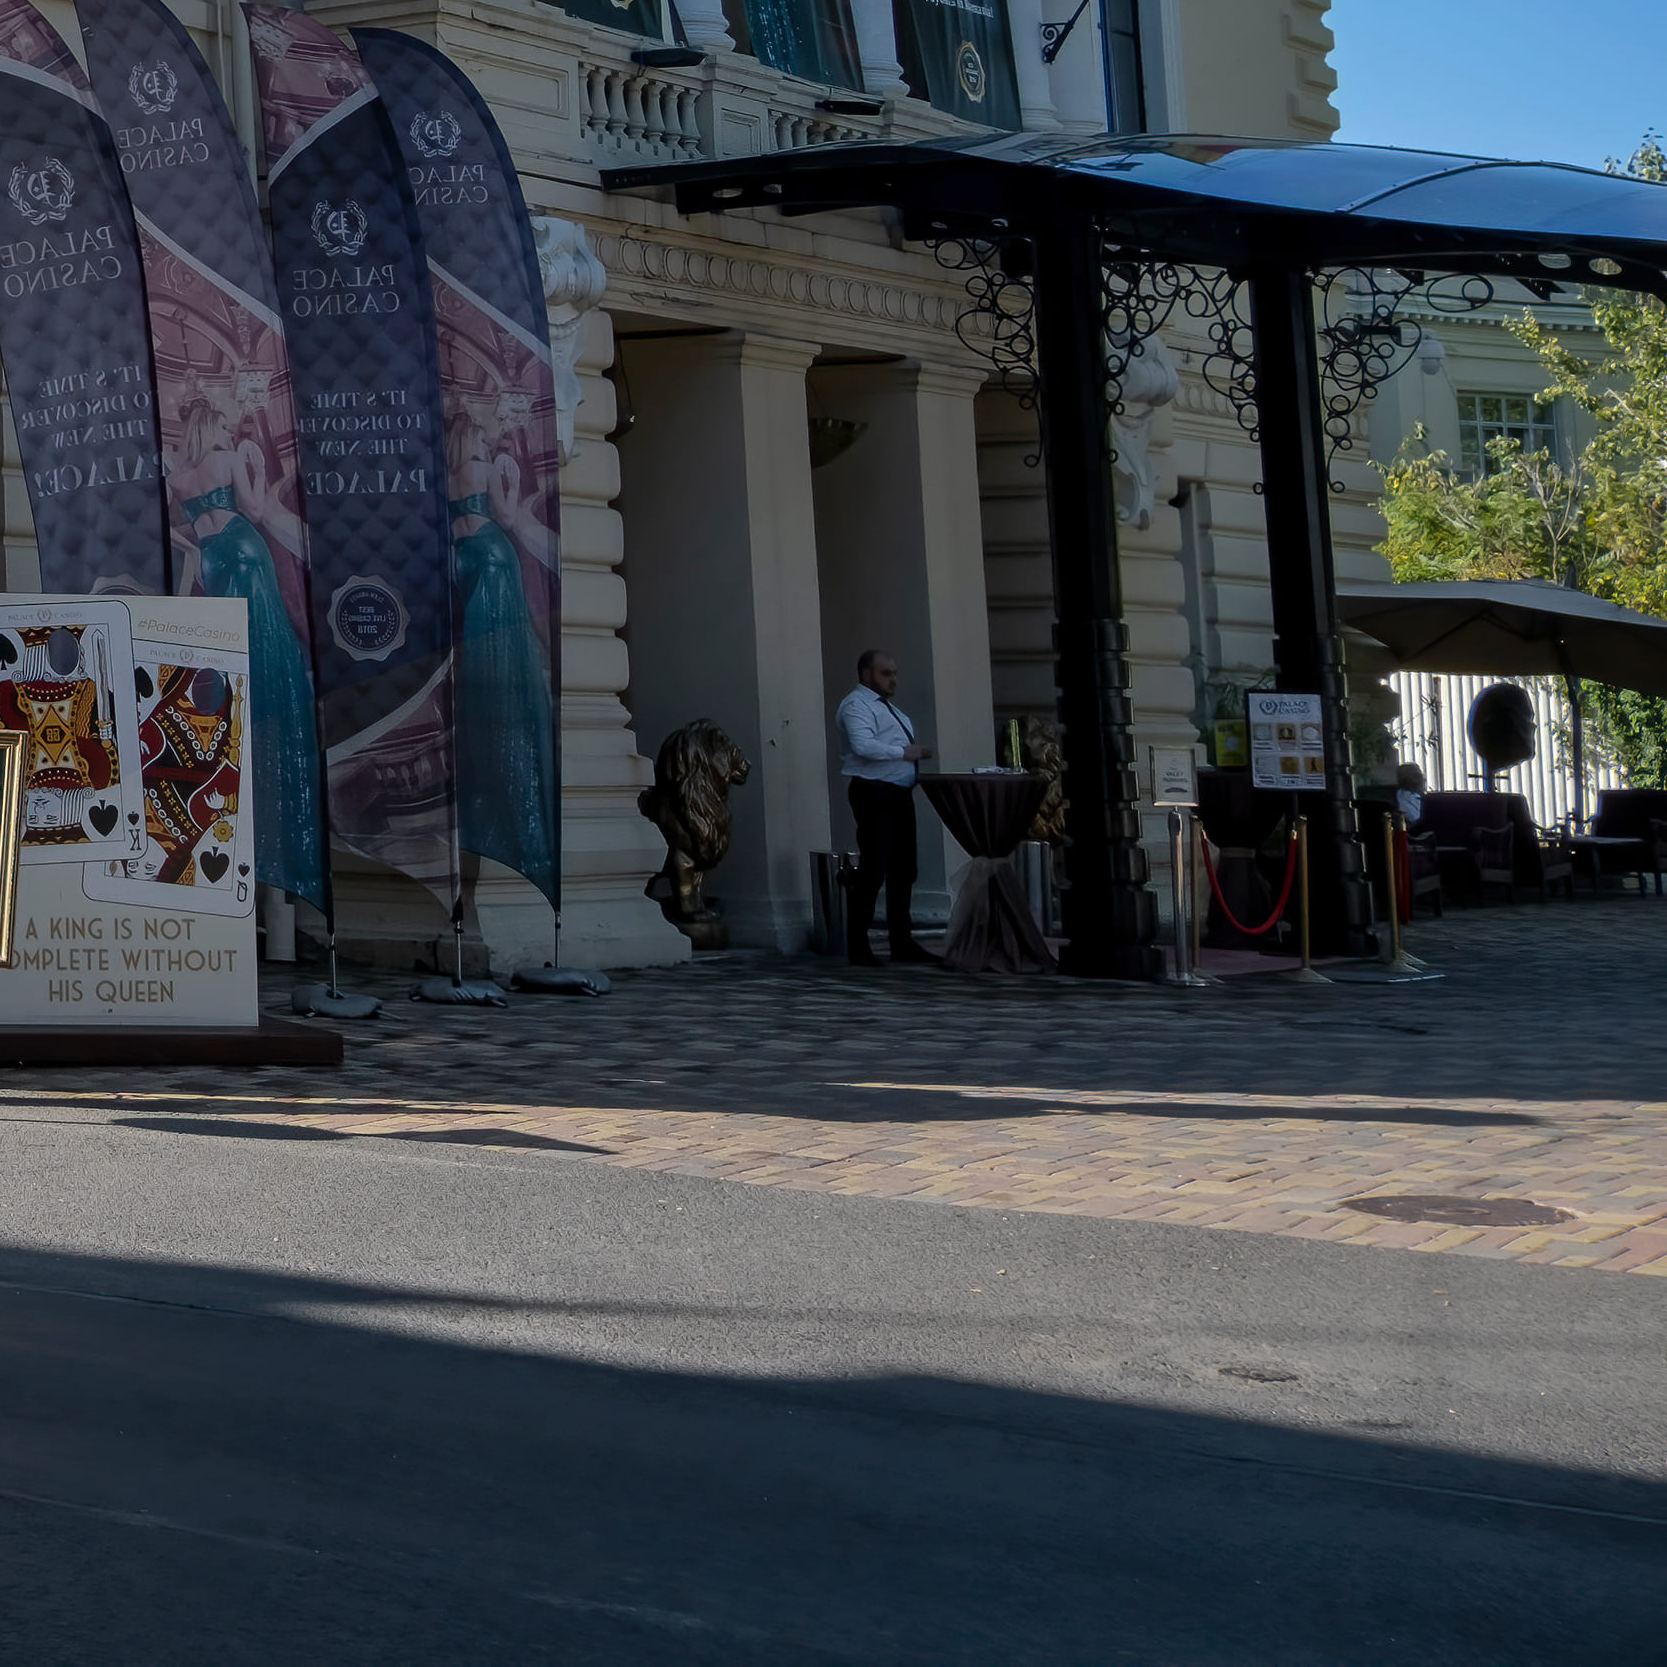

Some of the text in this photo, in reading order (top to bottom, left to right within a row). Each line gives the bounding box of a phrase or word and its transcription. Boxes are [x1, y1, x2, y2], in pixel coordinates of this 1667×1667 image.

[138, 619, 240, 642] #PalaceCasino
[128, 828, 142, 851] K
[25, 917, 195, 941] A KING IS NOT
[12, 948, 237, 972] MPLETE WITHOUT
[49, 980, 174, 1004] HIS QUEEN
